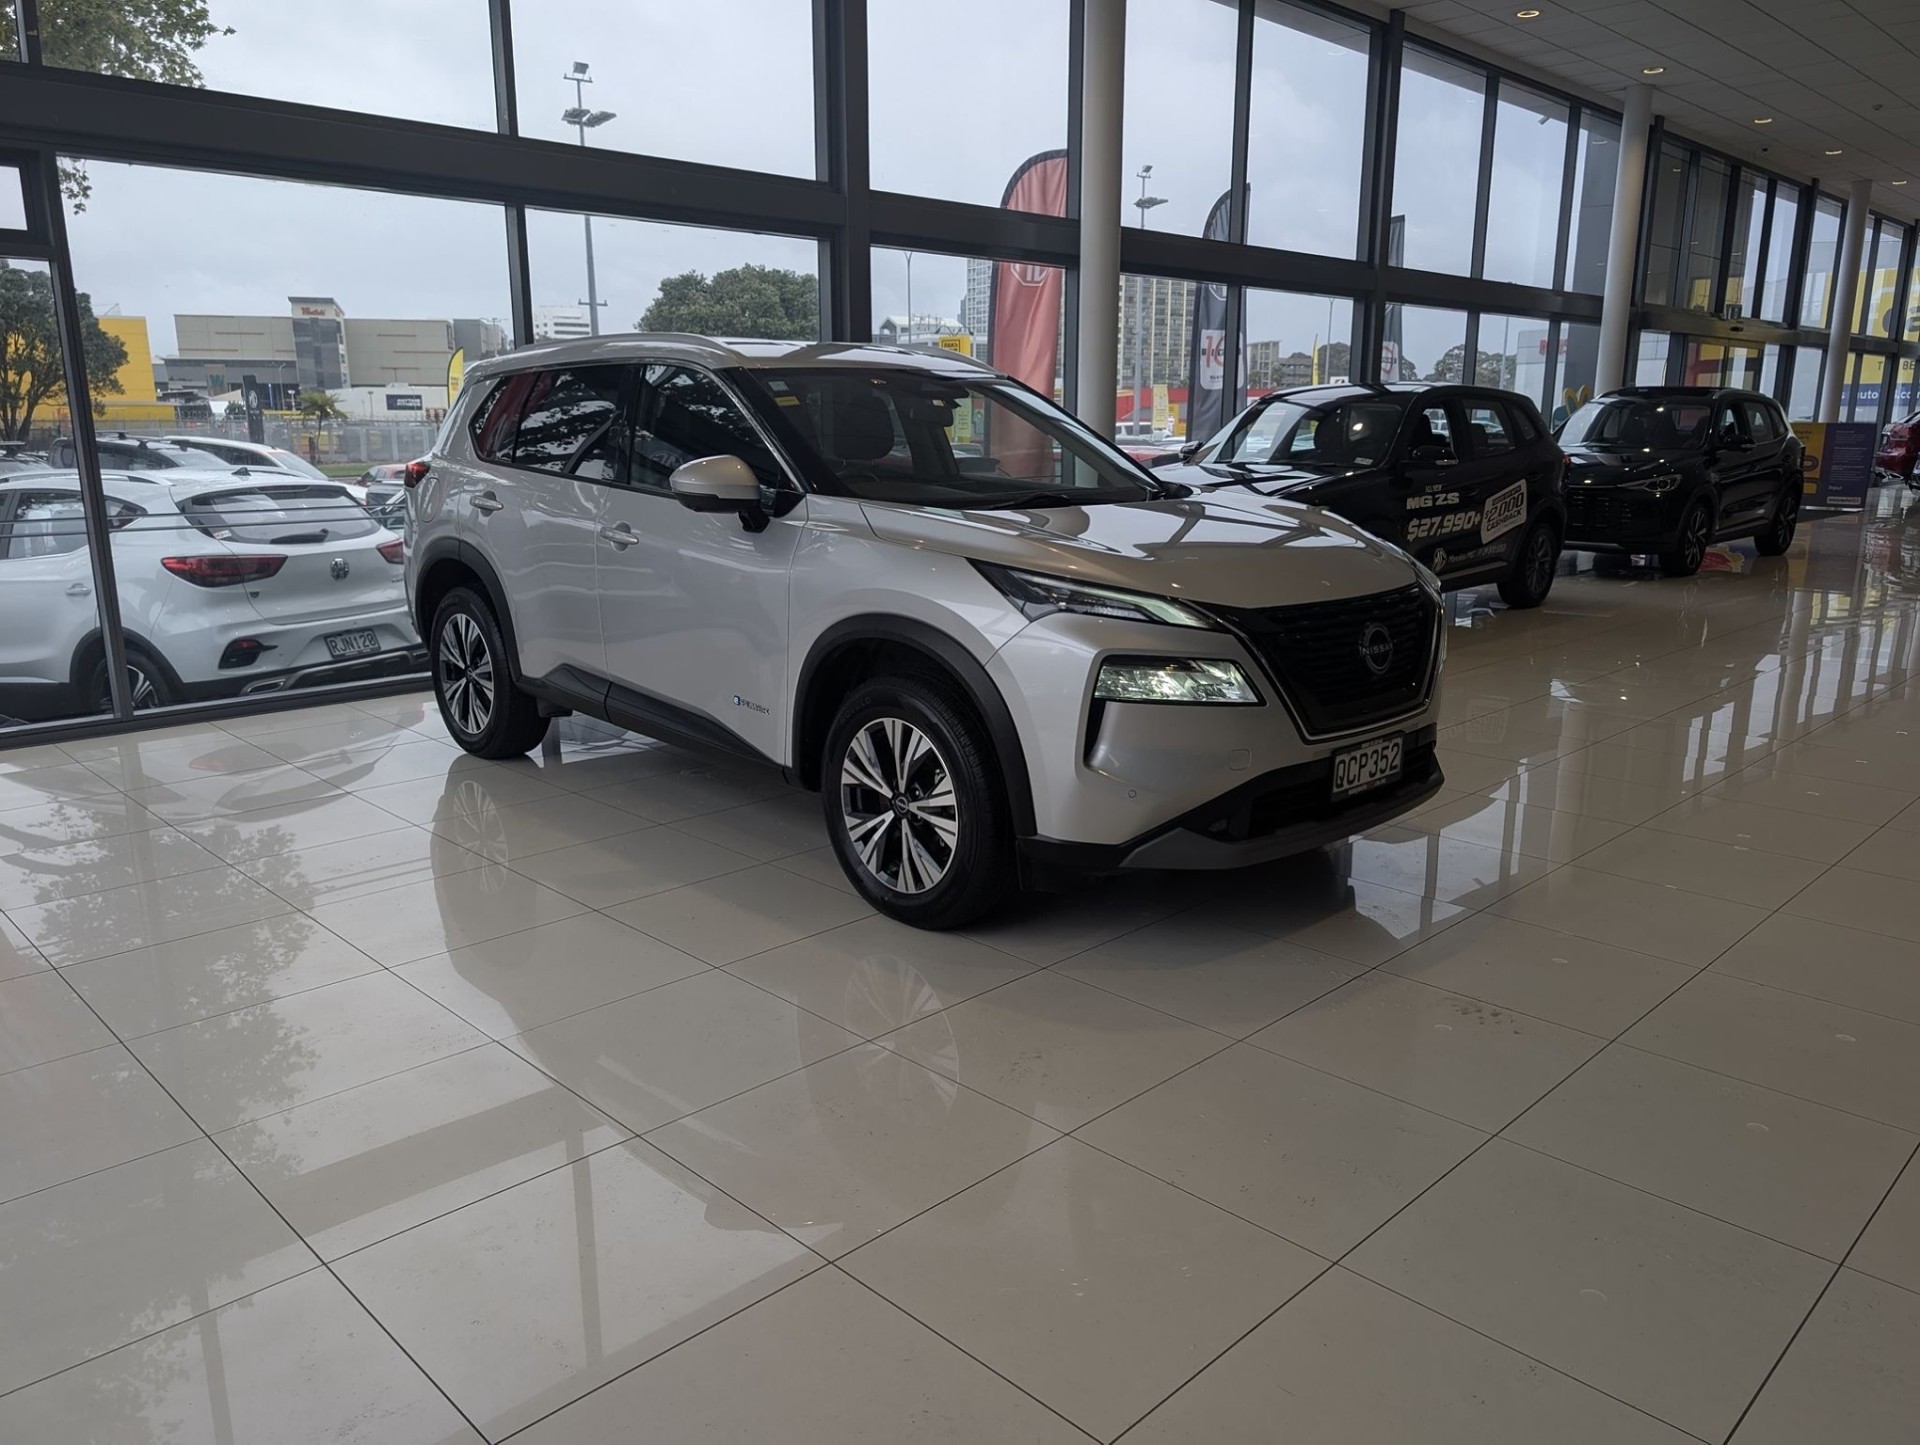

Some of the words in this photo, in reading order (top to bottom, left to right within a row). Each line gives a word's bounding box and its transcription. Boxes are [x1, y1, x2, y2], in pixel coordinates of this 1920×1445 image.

[1406, 495, 1433, 510] MG
[1435, 492, 1460, 506] ZS
[1407, 511, 1481, 542] $27,990+
[1486, 508, 1522, 532] CASHBACK
[1335, 742, 1400, 790] QCP352
